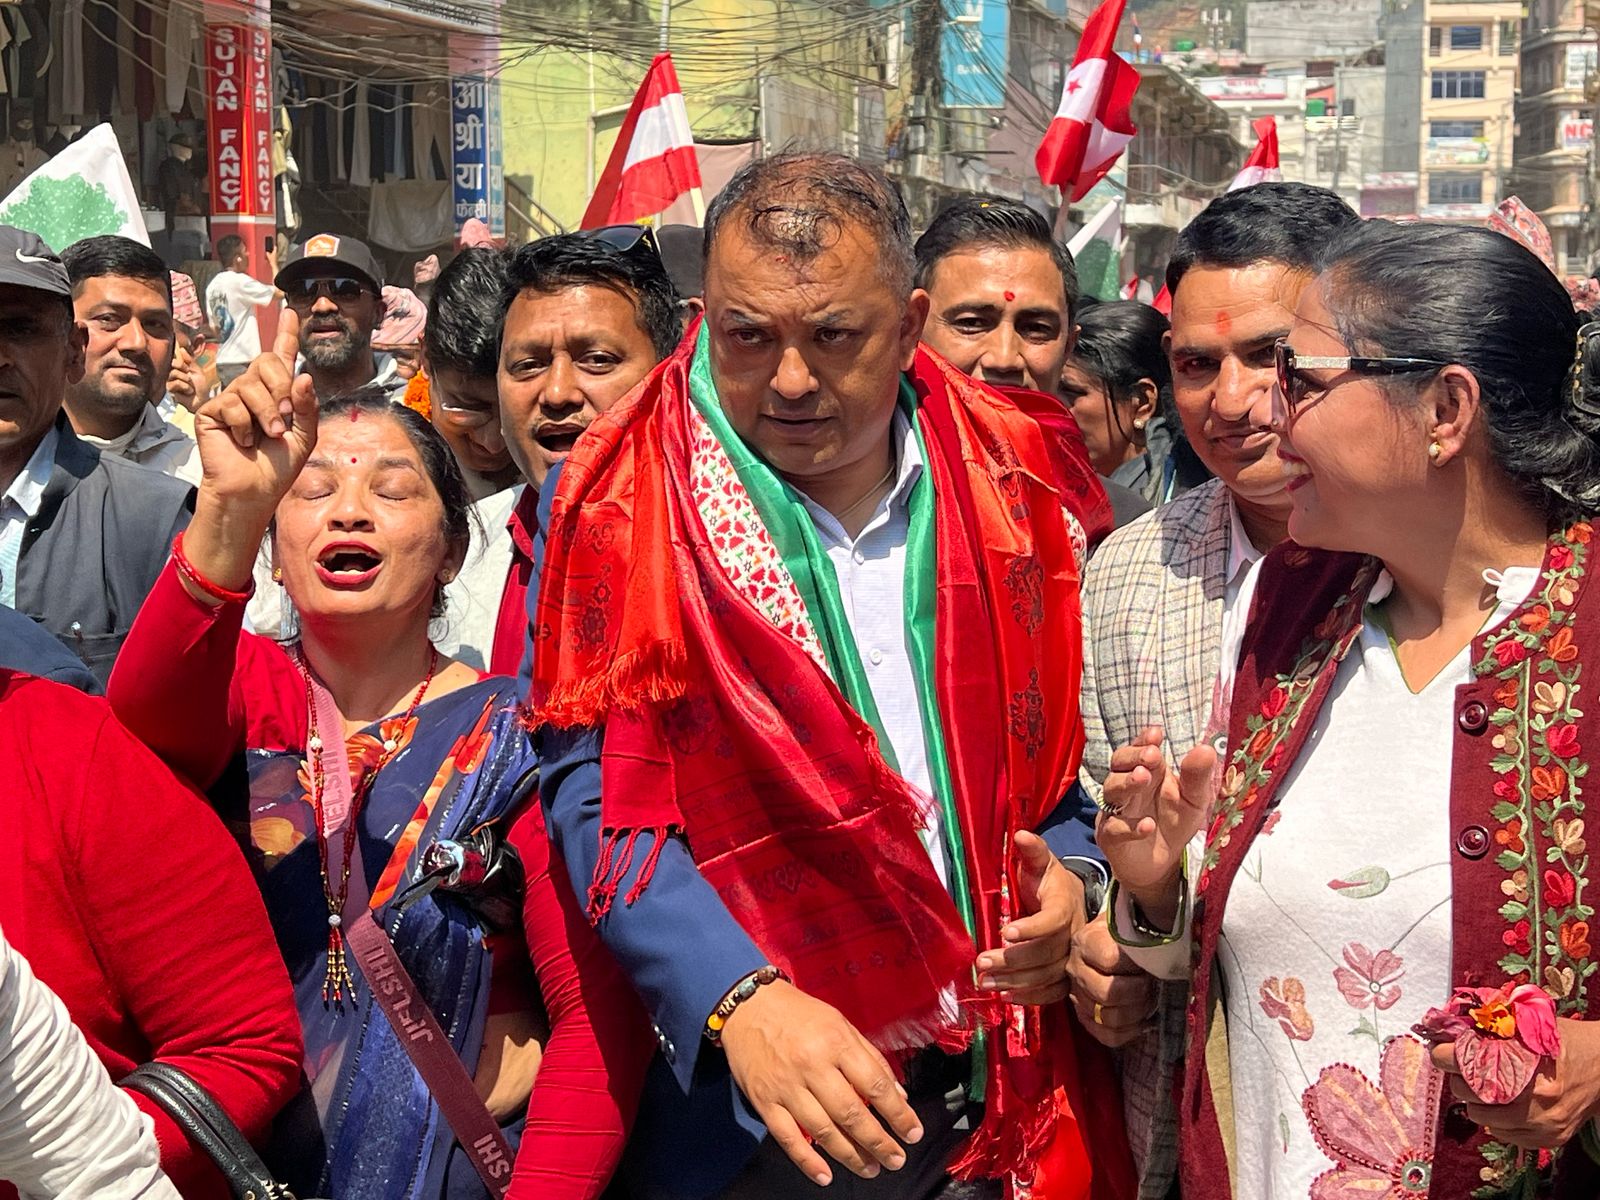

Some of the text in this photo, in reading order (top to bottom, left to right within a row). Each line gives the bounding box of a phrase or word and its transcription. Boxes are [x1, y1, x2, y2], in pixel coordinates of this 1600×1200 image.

[214, 28, 241, 211] SUJAN FANCY
[253, 31, 271, 212] SUJAN FANCY
